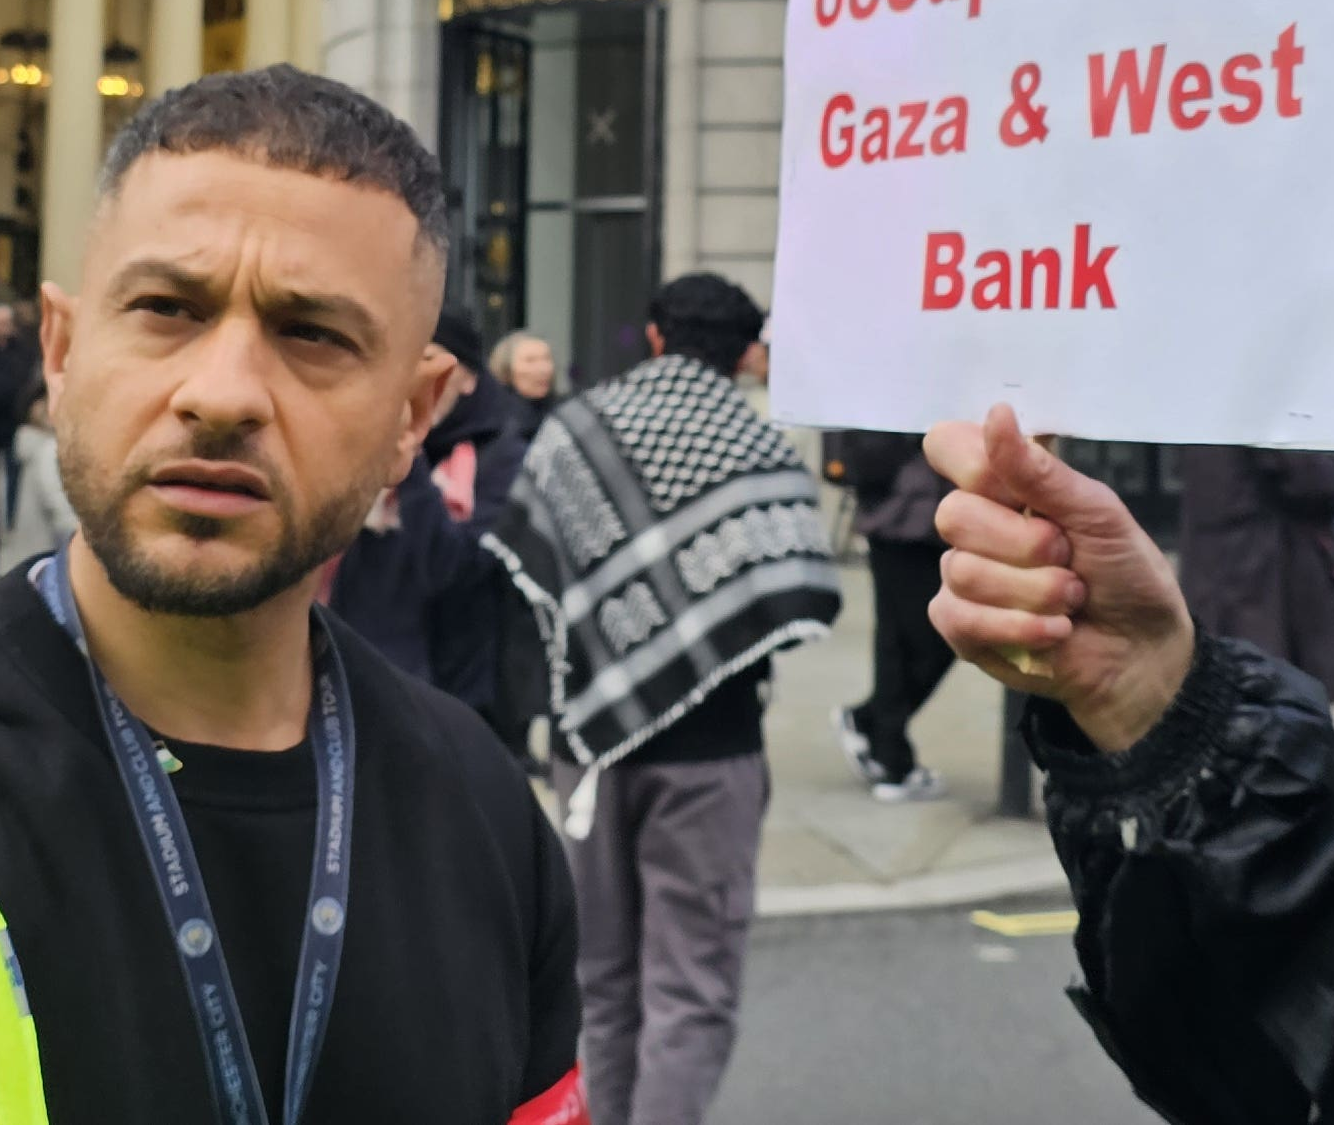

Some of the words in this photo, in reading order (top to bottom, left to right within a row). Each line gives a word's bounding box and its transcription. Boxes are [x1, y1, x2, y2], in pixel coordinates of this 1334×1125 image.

[819, 91, 969, 169] Gaza
[999, 61, 1049, 147] &
[1087, 21, 1305, 139] West
[921, 223, 1120, 312] Bank
